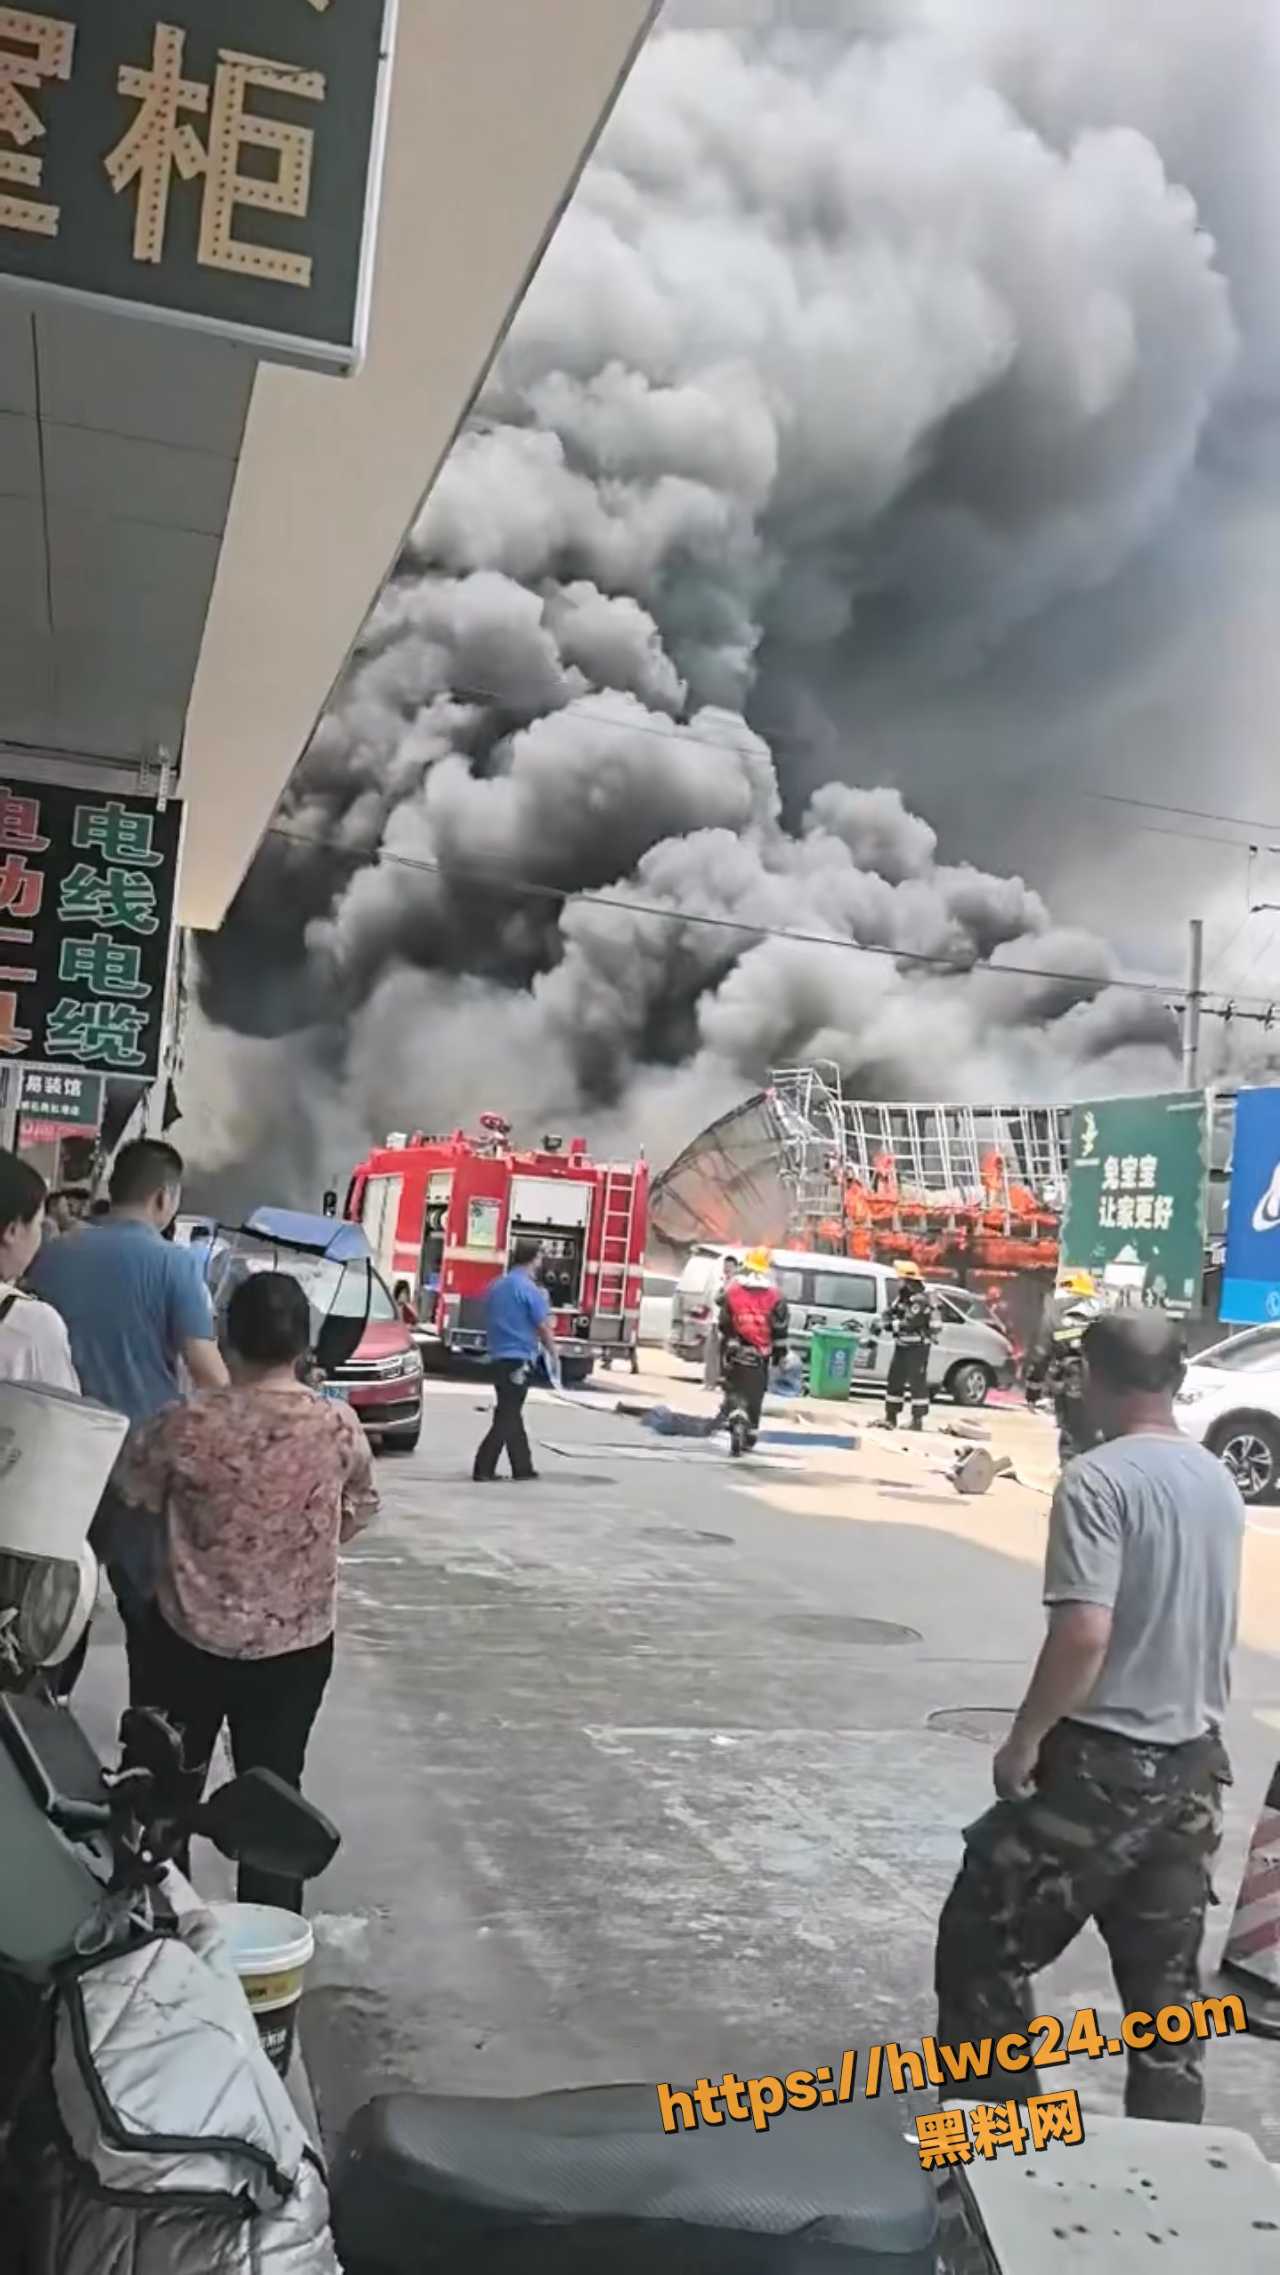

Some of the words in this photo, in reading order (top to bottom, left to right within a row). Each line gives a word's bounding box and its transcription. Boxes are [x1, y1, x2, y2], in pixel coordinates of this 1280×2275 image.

[44, 801, 164, 1067] 电线电缆
[1099, 1194, 1174, 1230] 让家更好
